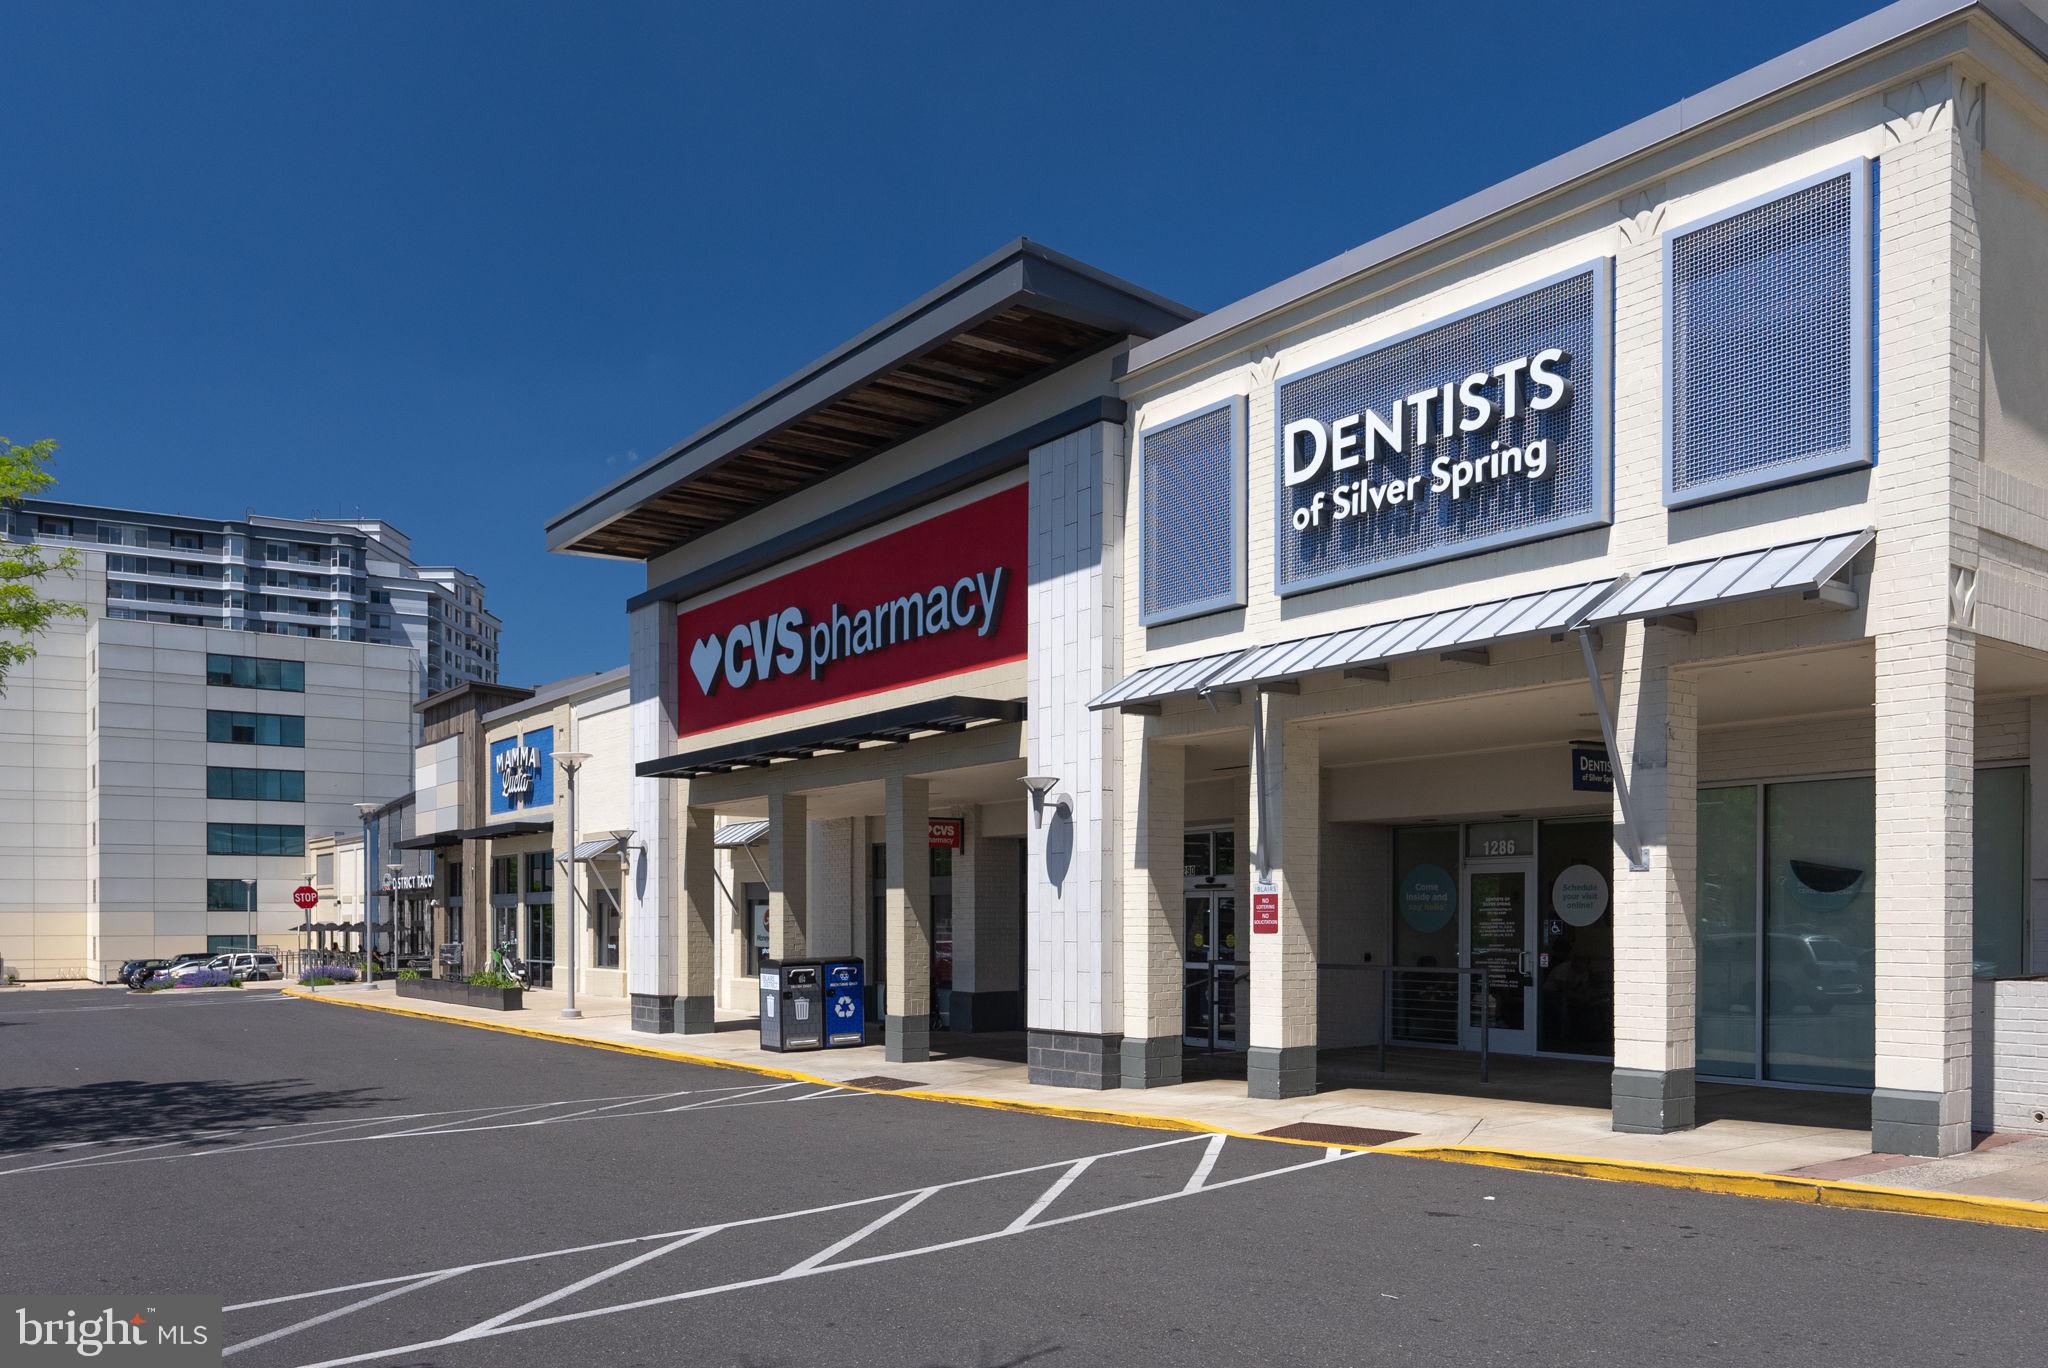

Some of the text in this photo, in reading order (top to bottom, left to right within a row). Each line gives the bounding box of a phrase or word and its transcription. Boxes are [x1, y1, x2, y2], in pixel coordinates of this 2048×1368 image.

[1284, 348, 1564, 487] DENTISTS
[1292, 438, 1548, 531] of Silver Spring
[724, 567, 1003, 689] CVS pharmacy
[496, 746, 536, 774] MAMMA
[933, 825, 955, 836] CVS
[1483, 839, 1515, 856] 1286
[392, 876, 416, 890] DSTRICT
[1415, 883, 1439, 891] Come
[1562, 883, 1599, 891] Schedule
[294, 892, 317, 902] STOP
[1431, 892, 1448, 901] and
[1562, 892, 1598, 901] your visit
